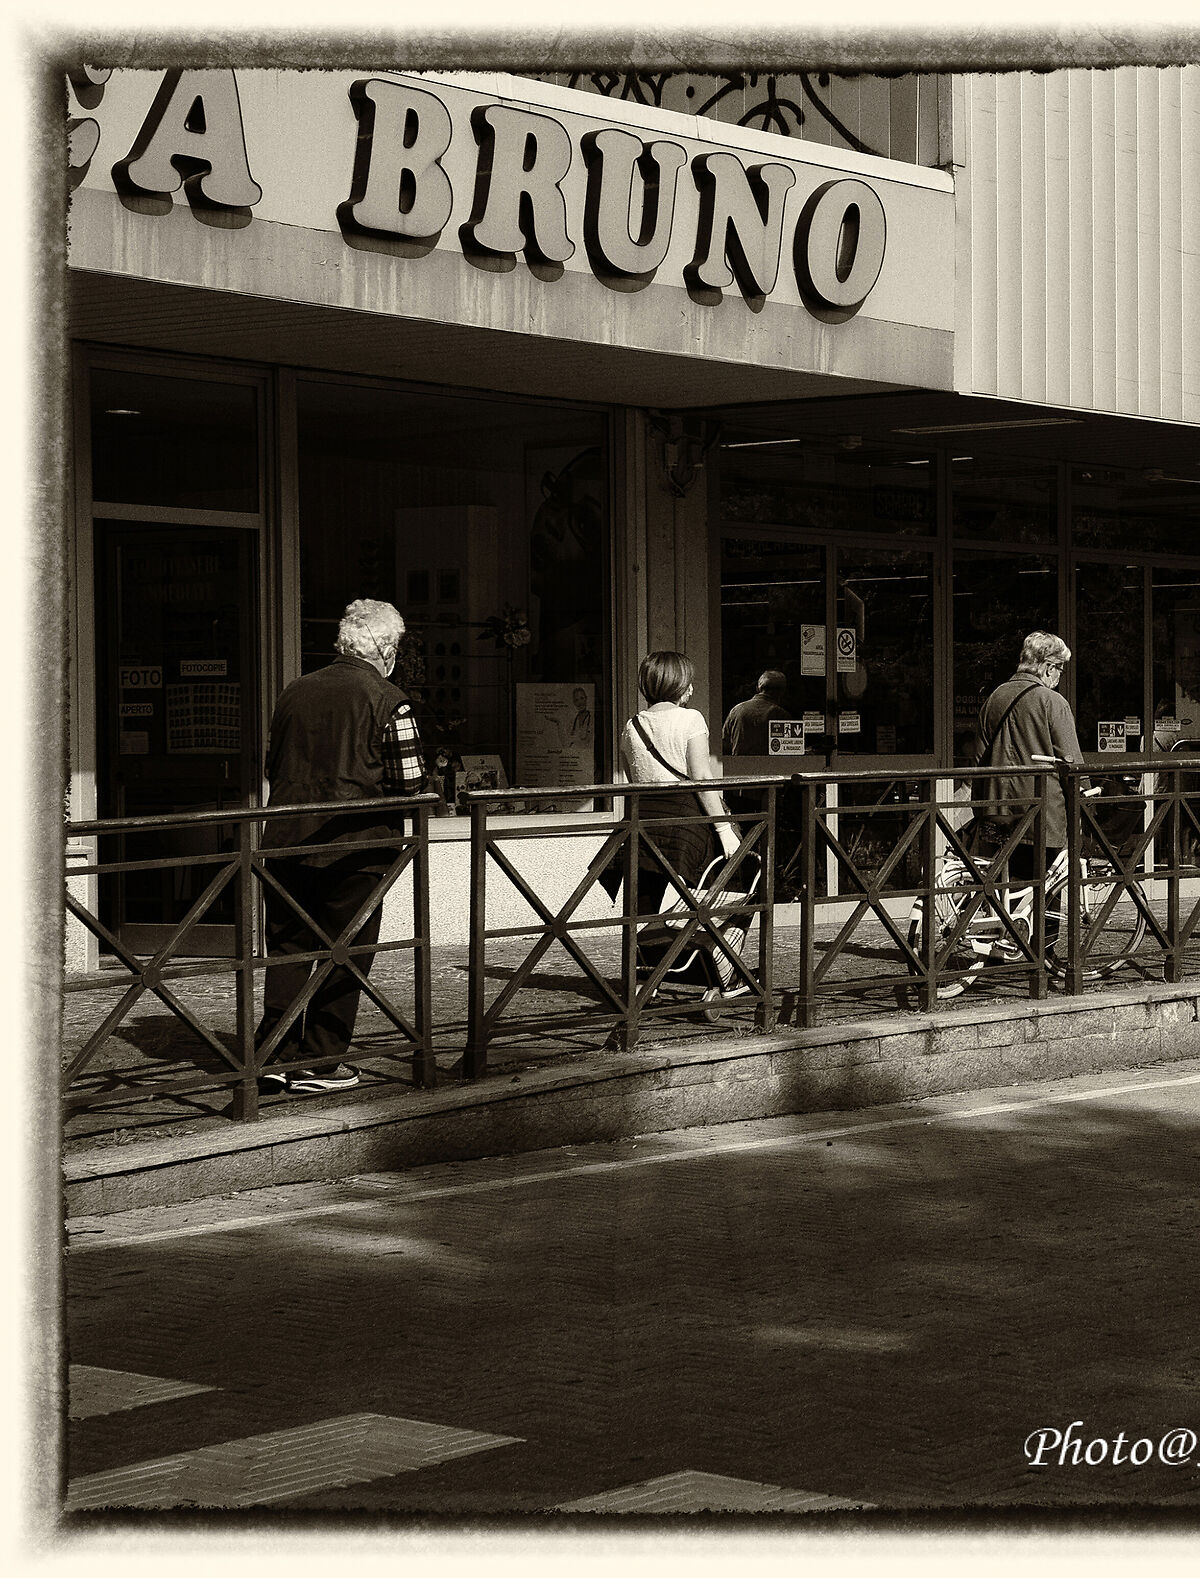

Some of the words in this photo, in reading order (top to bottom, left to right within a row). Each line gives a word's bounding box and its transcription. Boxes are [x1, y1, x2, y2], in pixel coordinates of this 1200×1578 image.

[338, 78, 887, 308] BRUNO
[183, 664, 225, 672] FOTOCOPIE
[121, 670, 161, 685] FOTO
[121, 705, 152, 714] APERTO
